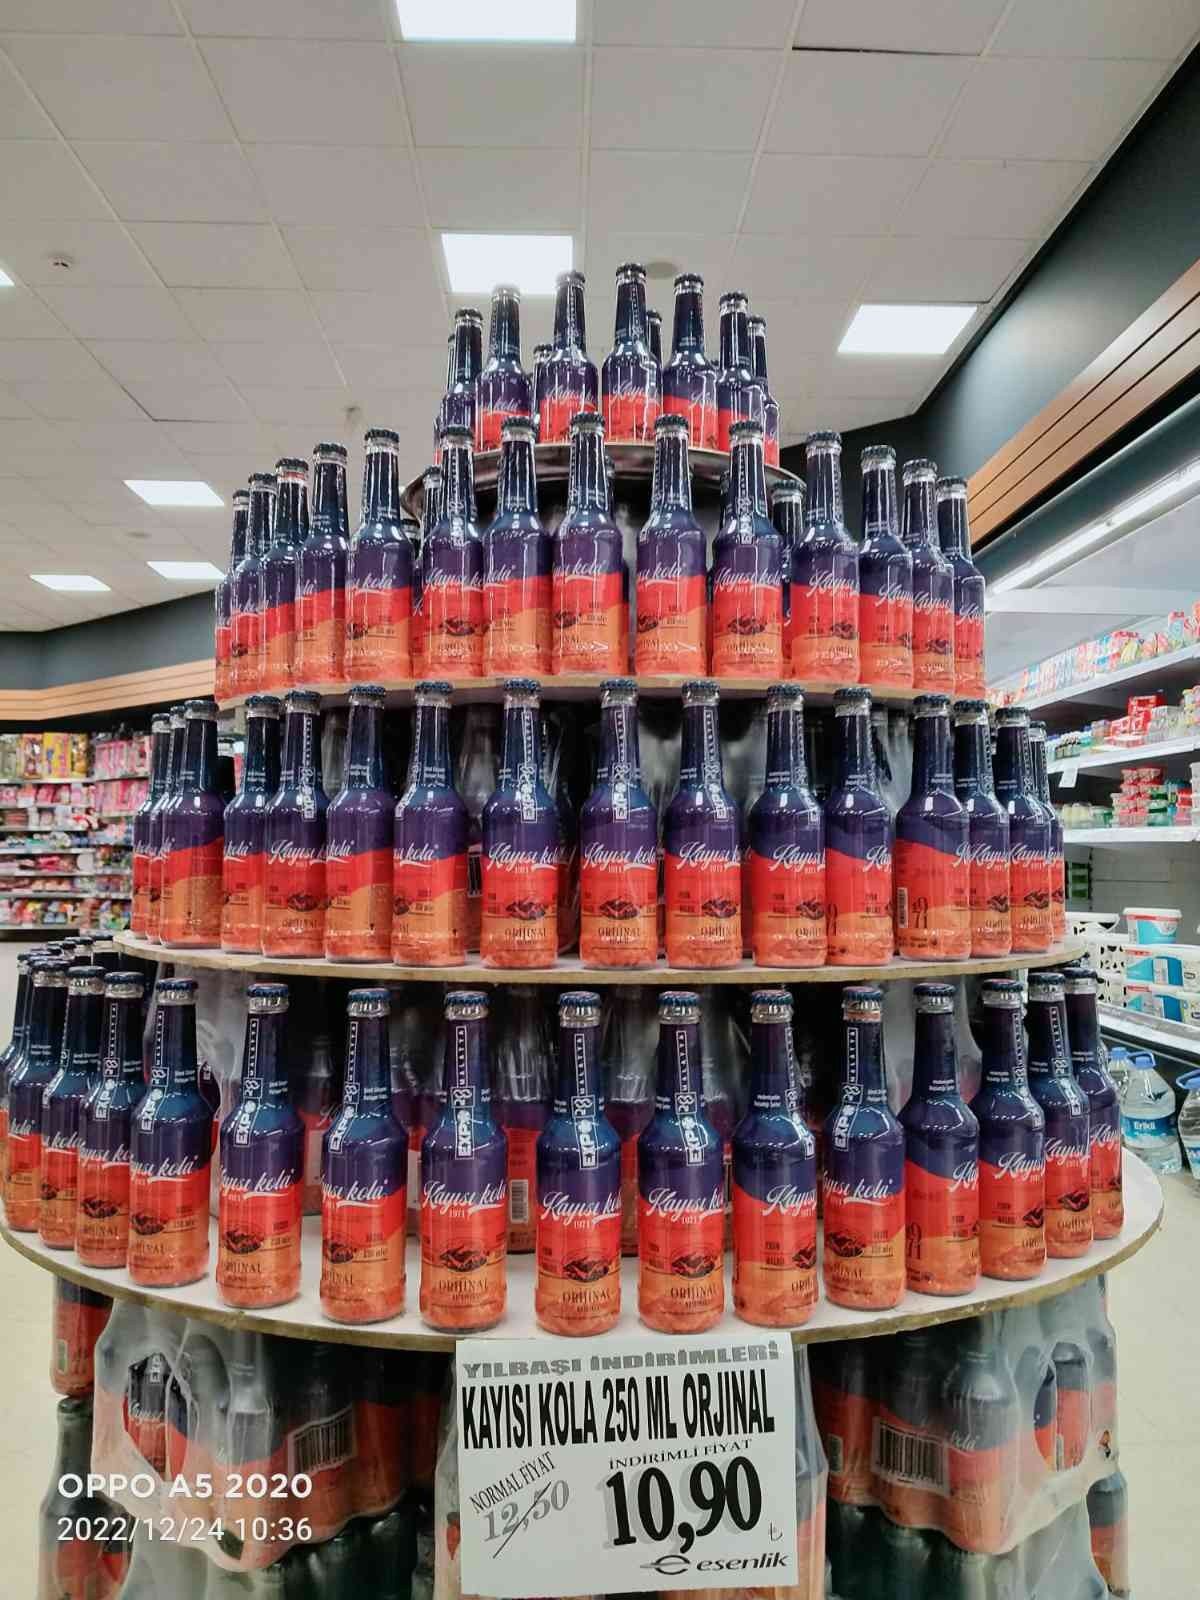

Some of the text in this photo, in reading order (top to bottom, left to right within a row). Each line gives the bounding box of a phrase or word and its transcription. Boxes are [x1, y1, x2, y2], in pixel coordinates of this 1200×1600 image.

[422, 1180, 477, 1215] Kayısı
[541, 1191, 599, 1226] Kayısı
[646, 1187, 706, 1222] Kayısı
[463, 1340, 780, 1378] YILBAŞI İNDİRİMLERİ
[462, 1368, 775, 1449] KAYISI KOLA 250 ML ORJINAL
[609, 1439, 753, 1470] İNDİRİMLİ FİYAT
[469, 1451, 556, 1514] NORMAL FİYAT
[484, 1480, 570, 1542] 12,50
[604, 1456, 762, 1554] 10,90
[697, 1552, 790, 1572] esenlik
